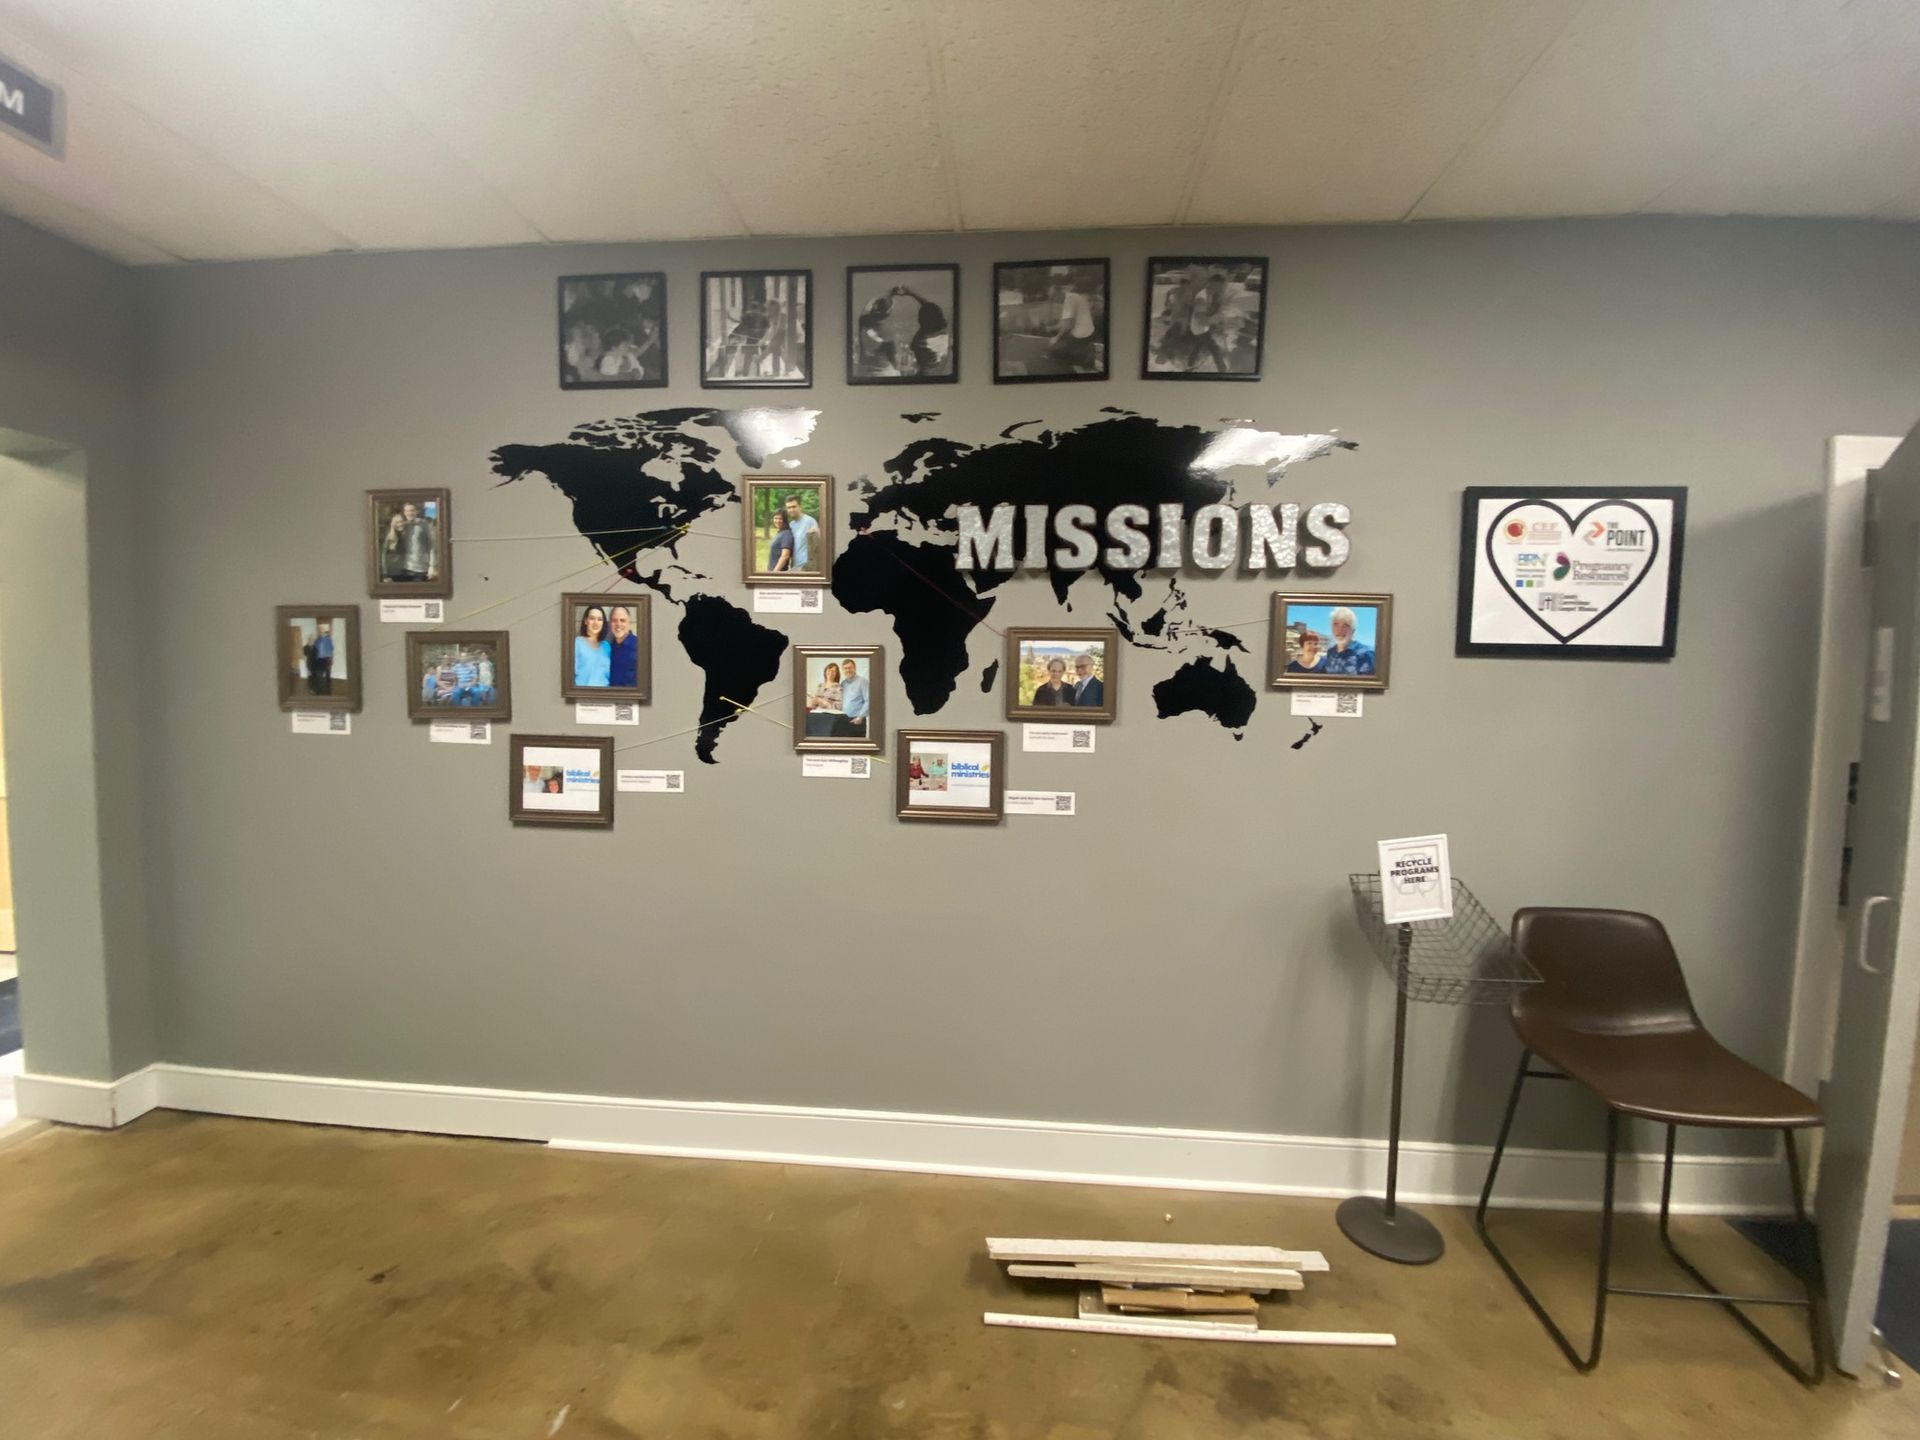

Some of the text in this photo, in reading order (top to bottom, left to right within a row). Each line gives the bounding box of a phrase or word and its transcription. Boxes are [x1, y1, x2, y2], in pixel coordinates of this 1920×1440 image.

[955, 503, 1351, 570] MISSIONS
[1607, 530, 1646, 546] POINT
[1395, 858, 1432, 867] RECYCLE
[1390, 866, 1439, 876] PROGRAMS
[1404, 876, 1425, 884] HERE
